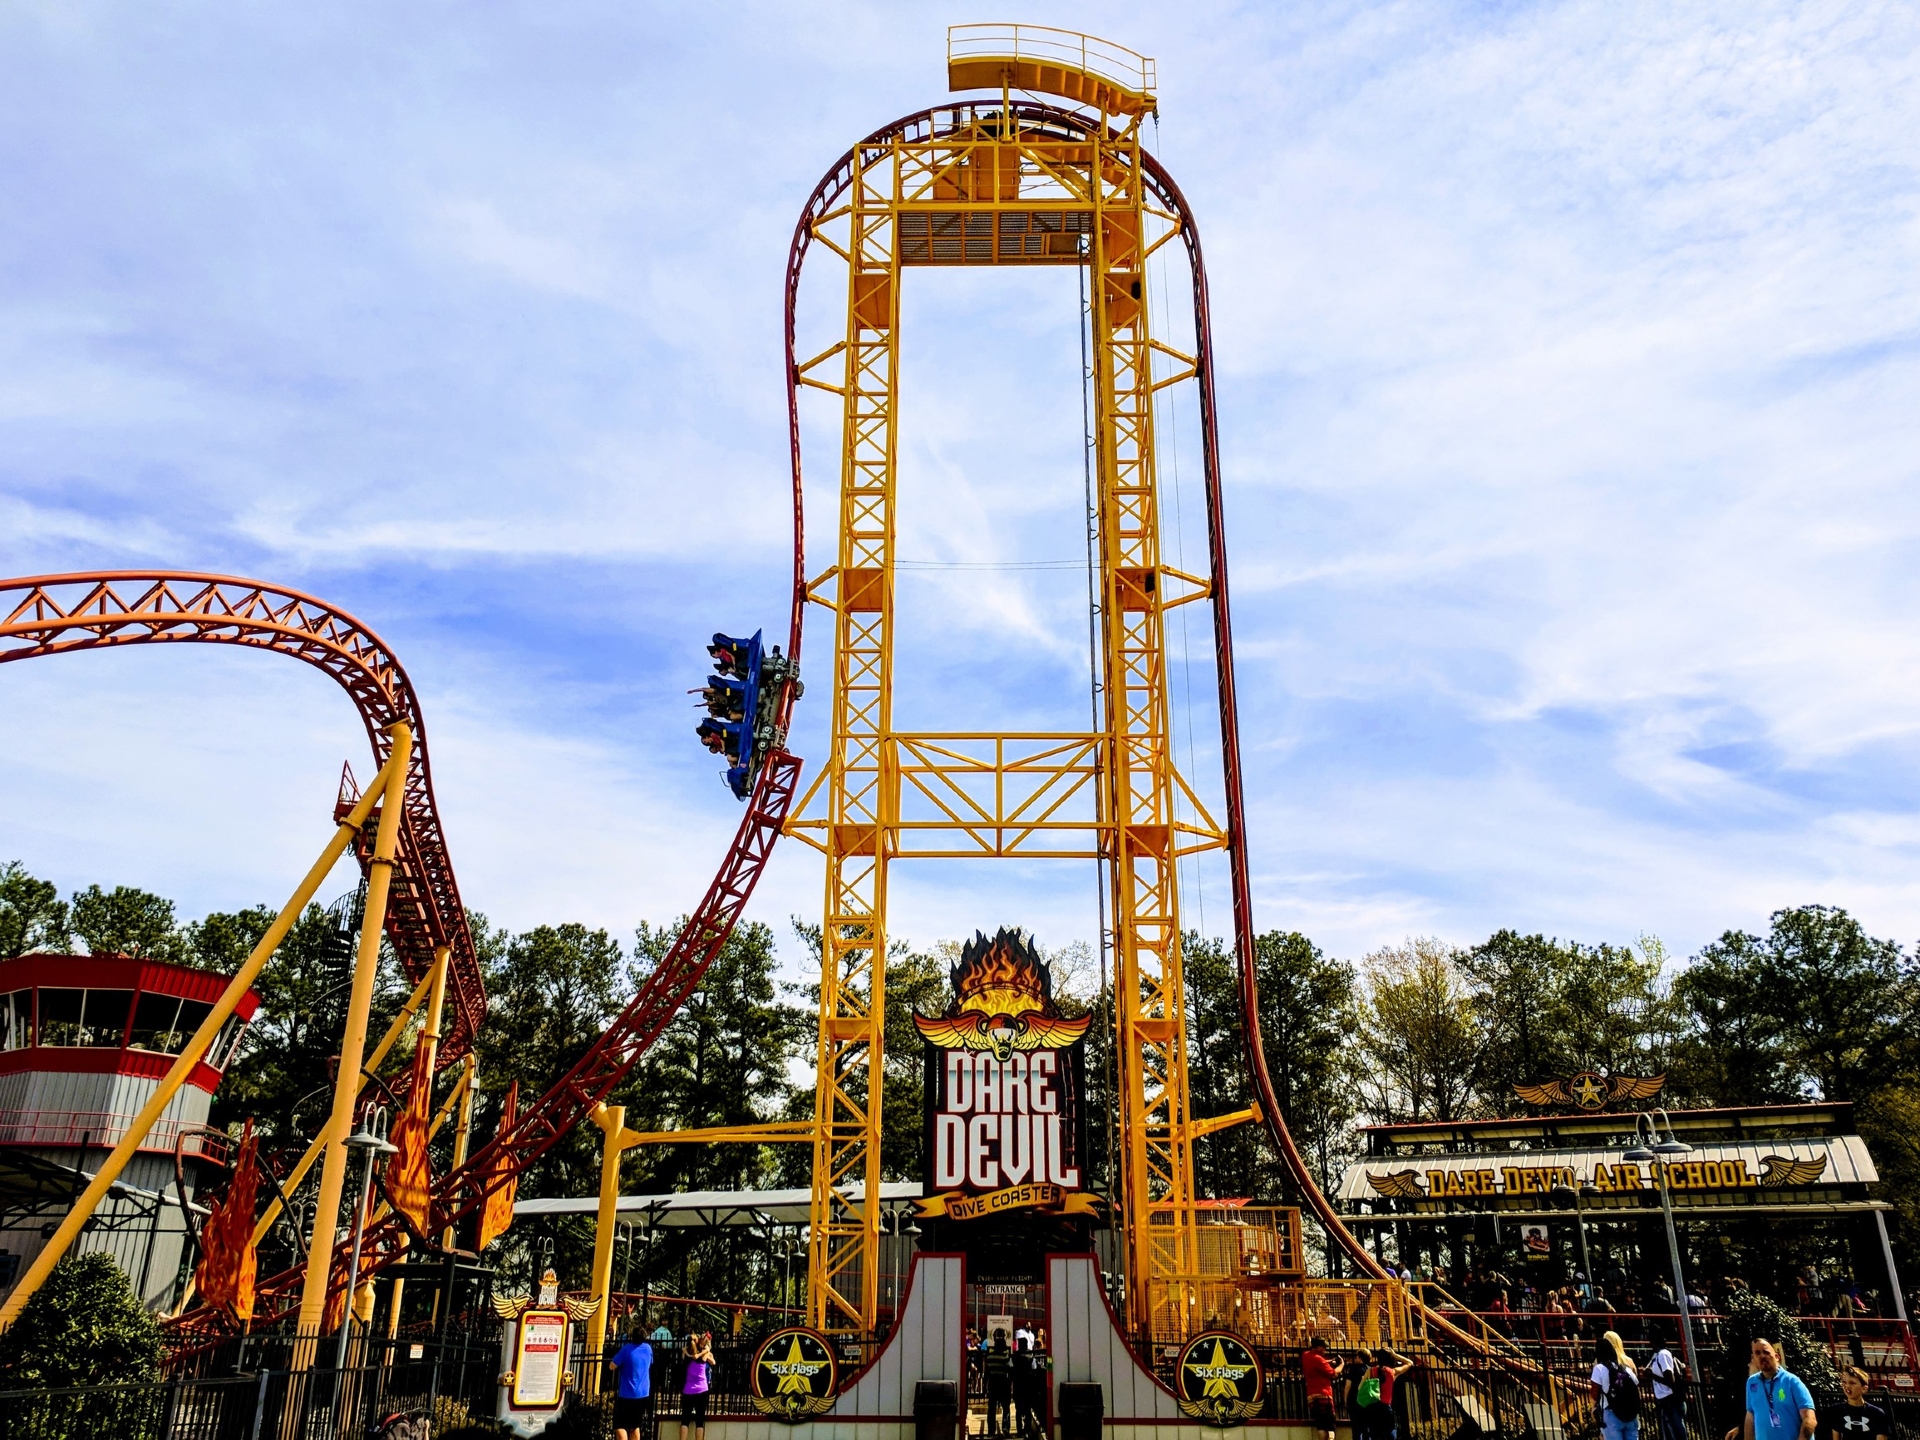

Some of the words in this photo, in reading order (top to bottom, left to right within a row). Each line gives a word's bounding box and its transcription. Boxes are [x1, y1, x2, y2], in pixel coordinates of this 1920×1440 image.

[946, 1052, 1057, 1114] DARE
[935, 1114, 1079, 1188] DEVIL
[1427, 1169, 1496, 1198] DARE
[1595, 1162, 1644, 1192] AIR
[1650, 1160, 1758, 1191] SCHOOL
[952, 1200, 986, 1217] DIVE
[991, 1186, 1061, 1208] COASTER
[986, 1285, 1024, 1293] ENTRANCE
[771, 1363, 788, 1374] Six
[791, 1363, 819, 1376] Flags
[1195, 1366, 1214, 1378] Six
[1216, 1366, 1245, 1380] Flags
